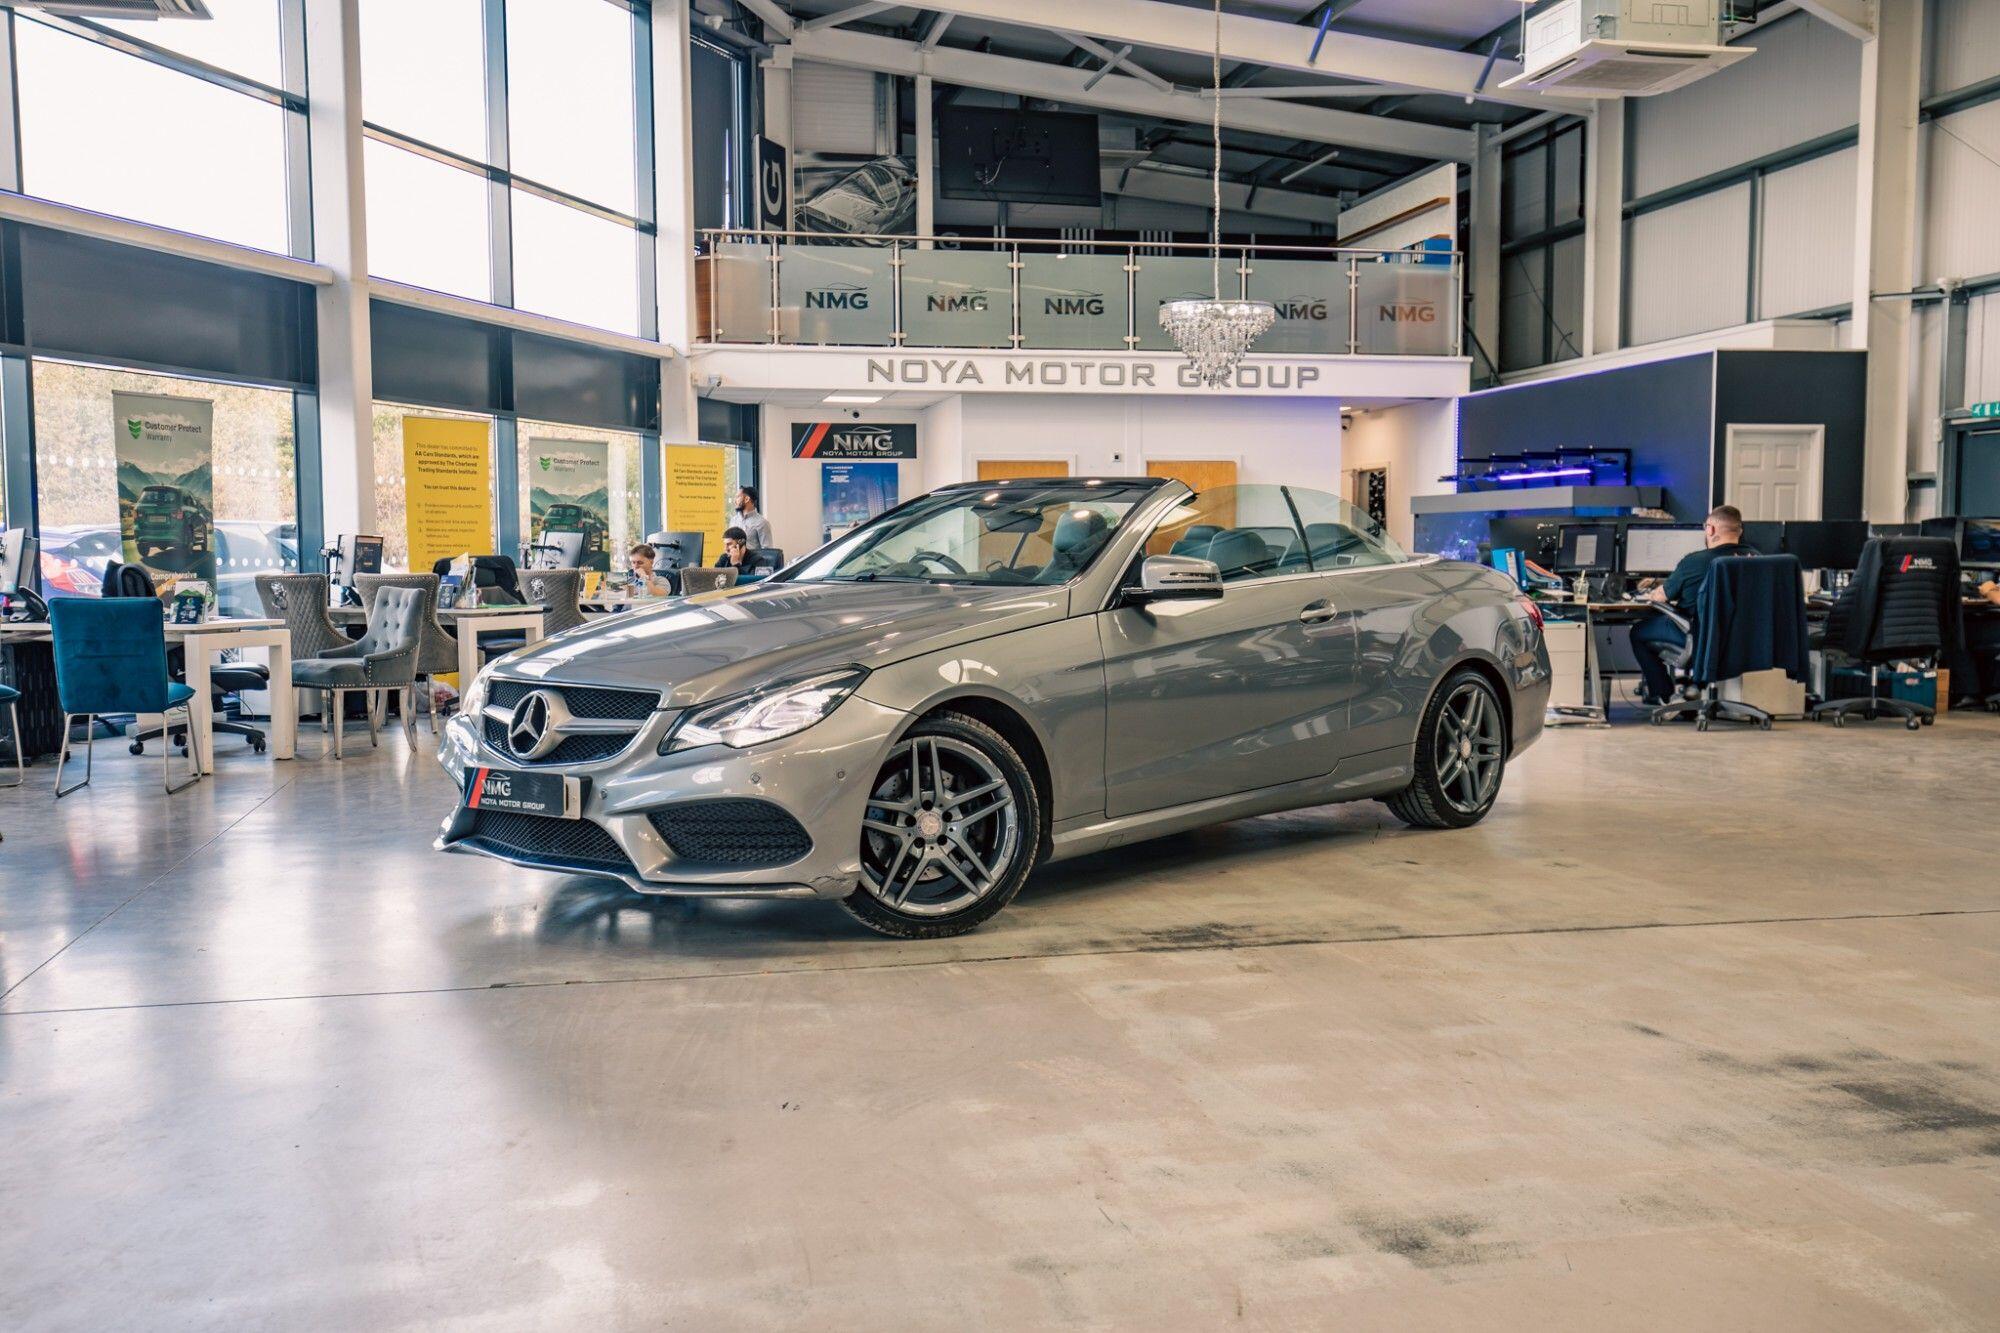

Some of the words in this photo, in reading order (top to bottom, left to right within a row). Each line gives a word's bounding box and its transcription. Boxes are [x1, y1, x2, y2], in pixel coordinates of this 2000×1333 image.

[805, 290, 869, 310] NMG
[926, 295, 989, 313] NMG
[1044, 297, 1105, 316] NMG
[1273, 302, 1328, 321] NMG
[1379, 304, 1436, 323] NMG
[867, 357, 984, 385] NOYA
[1005, 360, 1156, 387] MOTOR
[144, 421, 176, 432] Customer
[177, 423, 202, 434] Protect
[832, 433, 894, 451] NMG
[480, 779, 511, 796] NMG
[481, 798, 497, 806] NOYA
[498, 799, 521, 809] MOTOR
[522, 801, 546, 811] GROUP
